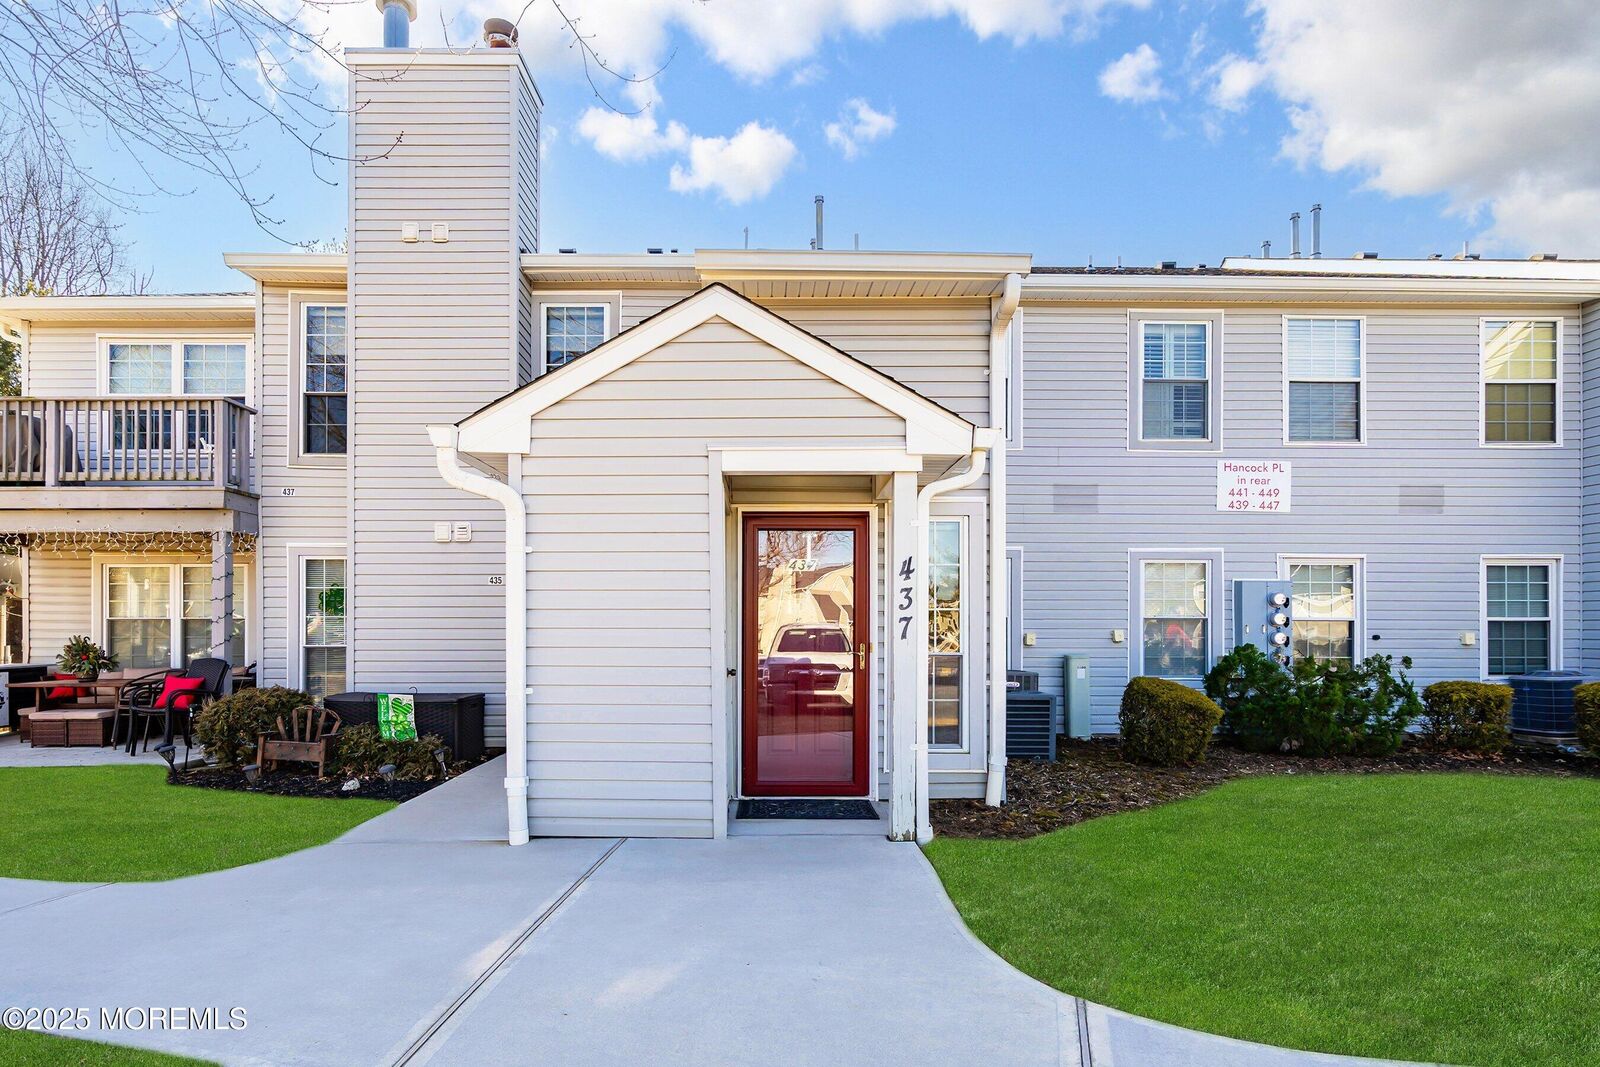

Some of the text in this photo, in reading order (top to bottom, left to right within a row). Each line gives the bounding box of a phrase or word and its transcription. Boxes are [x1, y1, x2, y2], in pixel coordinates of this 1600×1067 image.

[1223, 462, 1285, 473] Hancock PL
[1237, 475, 1247, 485] in
[1228, 488, 1248, 497] 441
[1258, 488, 1280, 498] 449
[1228, 500, 1249, 510] 439
[1259, 500, 1280, 510] 447
[490, 576, 503, 584] 435
[379, 697, 390, 738] WELCOM
